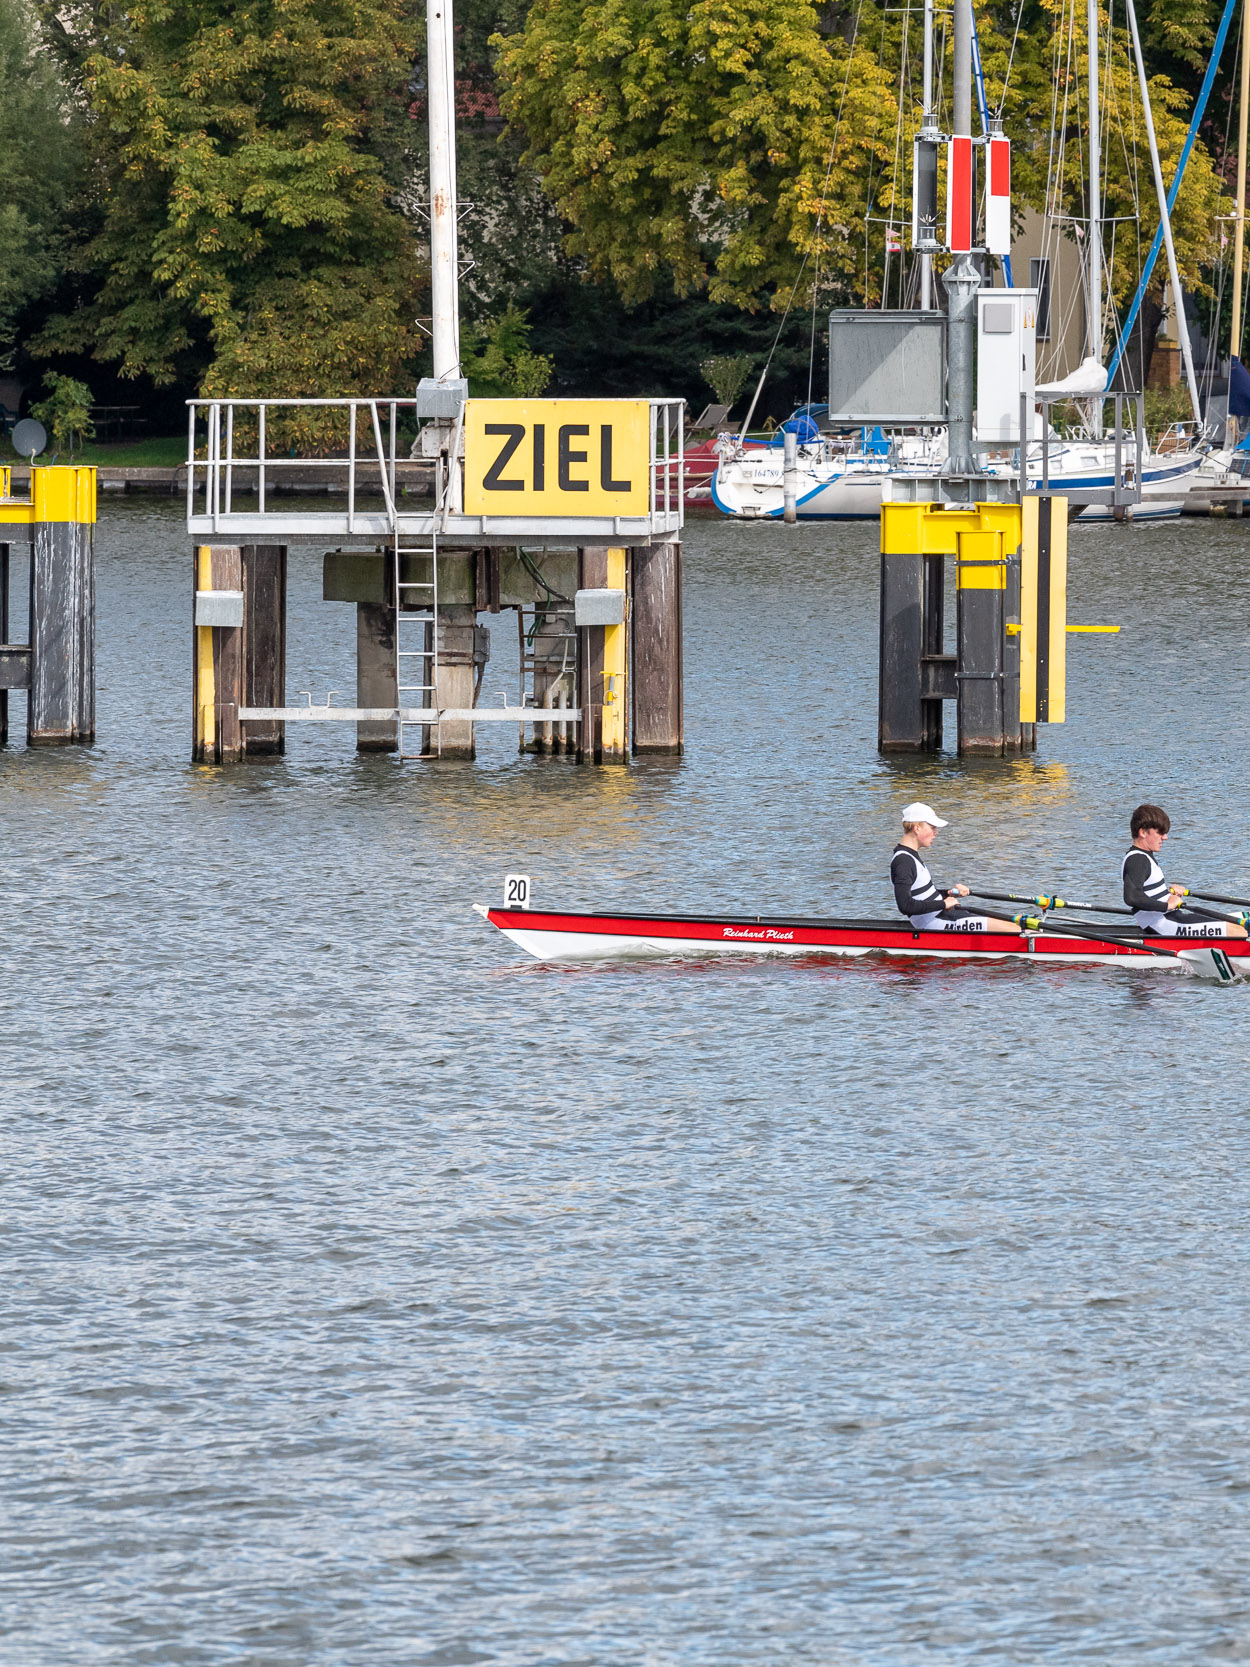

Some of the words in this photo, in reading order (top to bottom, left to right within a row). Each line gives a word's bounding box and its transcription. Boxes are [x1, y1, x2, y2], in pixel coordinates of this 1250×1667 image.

[482, 424, 632, 492] ZIEL
[508, 879, 527, 902] 20
[943, 920, 983, 931] Minden
[1175, 924, 1222, 937] Minden
[722, 927, 765, 939] Reinhard
